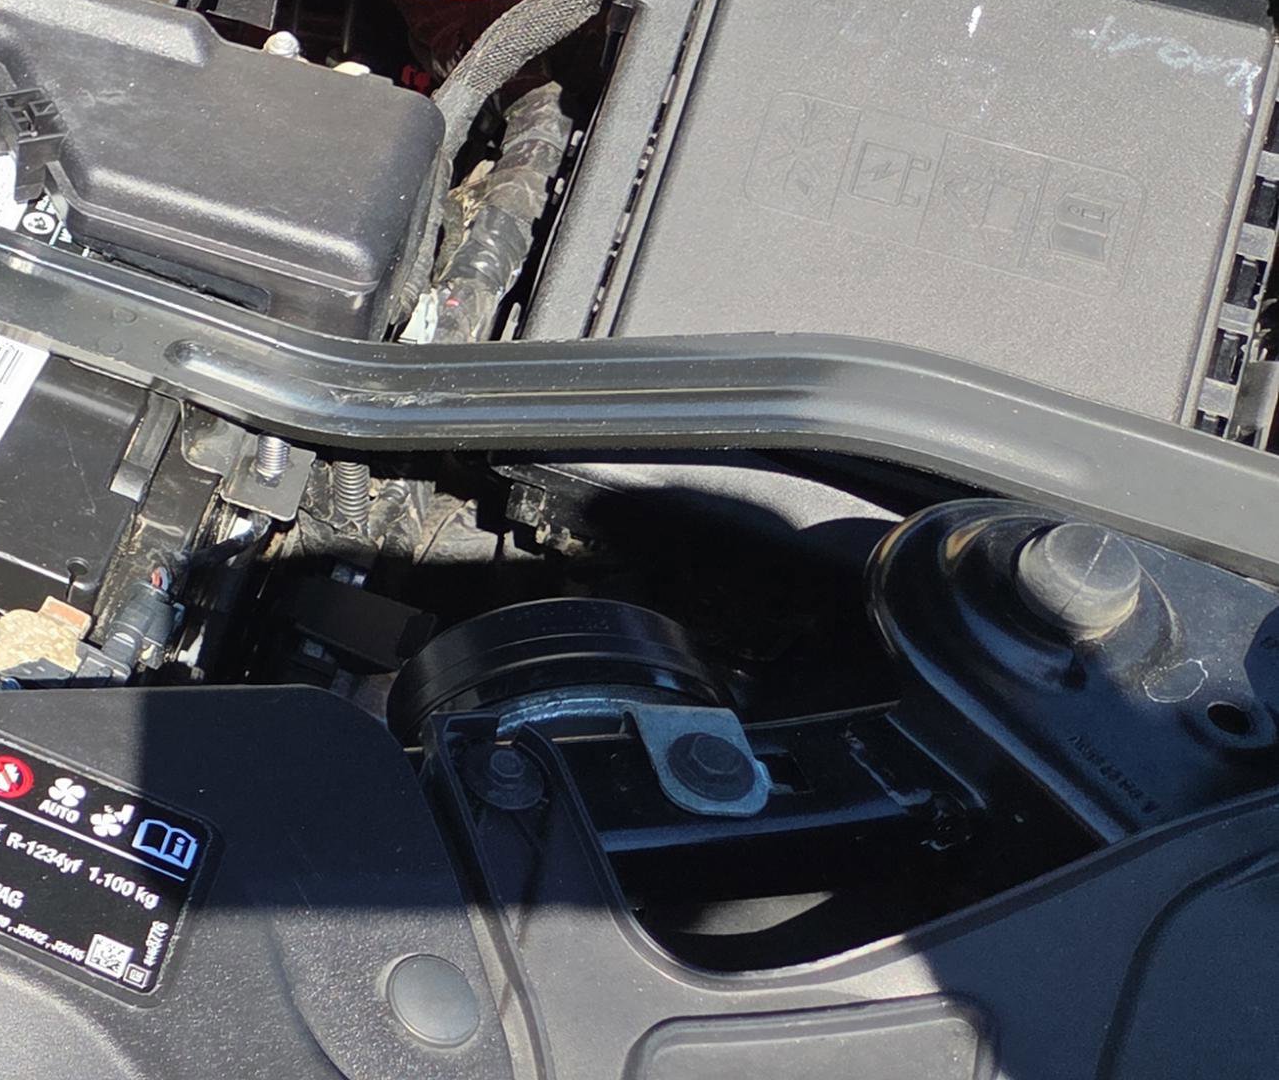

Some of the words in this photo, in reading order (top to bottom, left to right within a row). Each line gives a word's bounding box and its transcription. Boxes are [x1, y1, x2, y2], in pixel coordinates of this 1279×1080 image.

[38, 799, 80, 823] AUTO
[5, 831, 84, 874] R-1234yf
[88, 866, 134, 897] 1.100
[133, 882, 160, 909] kg
